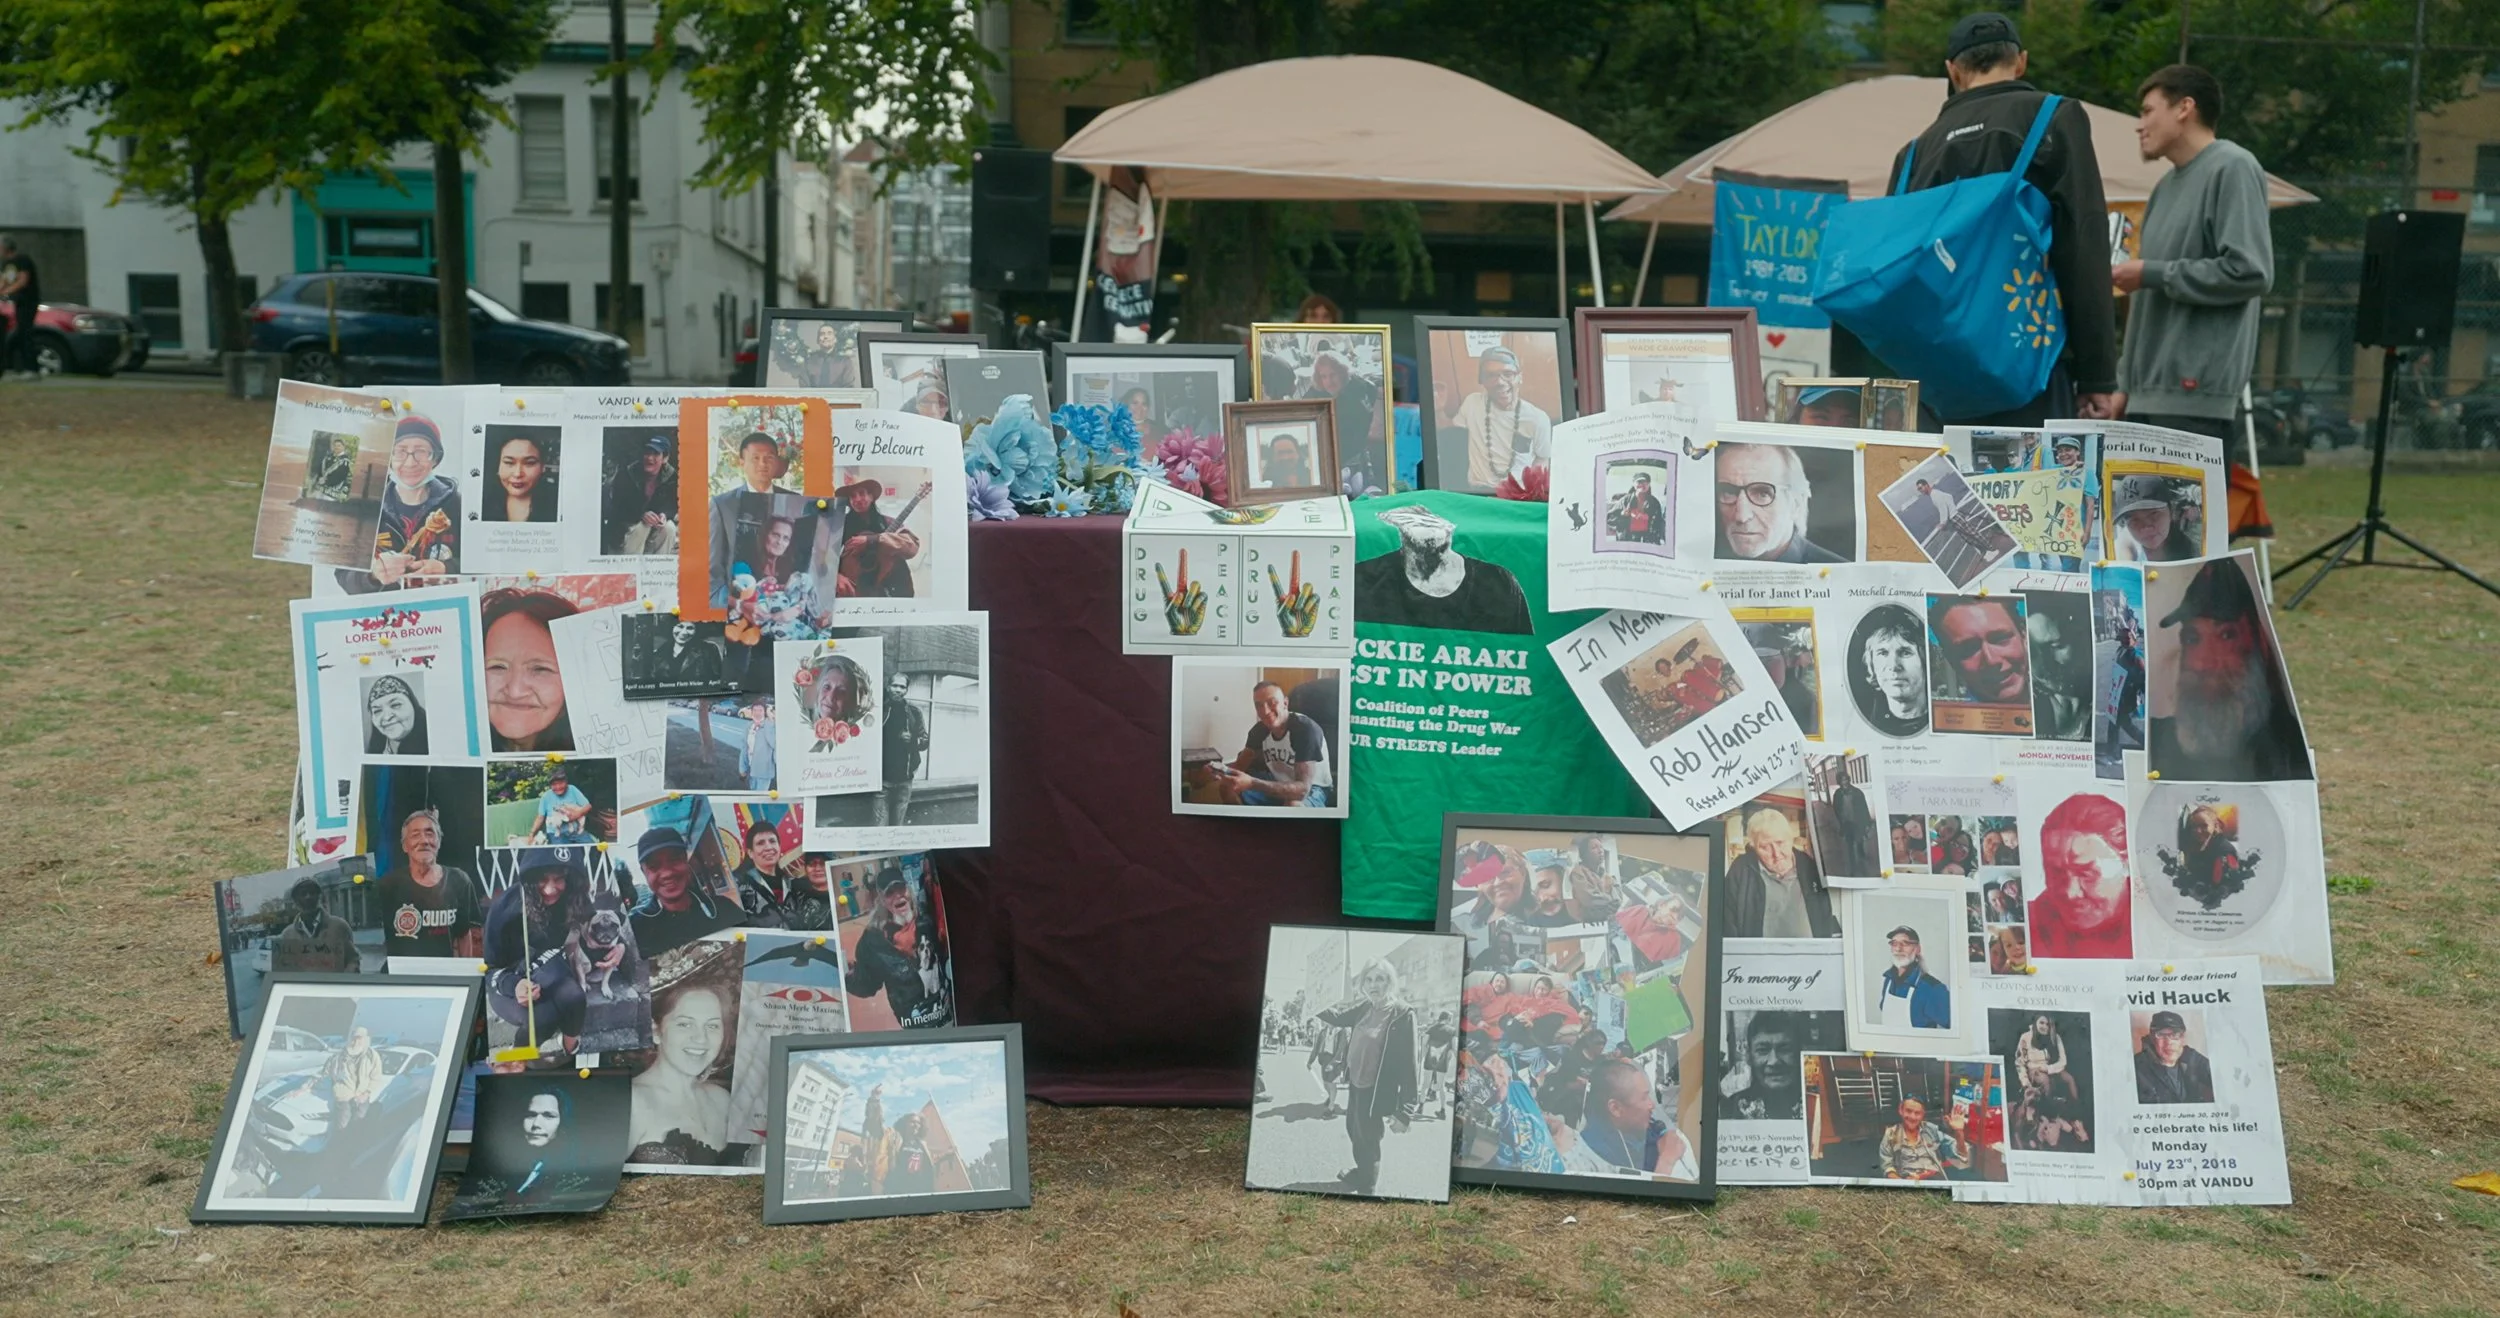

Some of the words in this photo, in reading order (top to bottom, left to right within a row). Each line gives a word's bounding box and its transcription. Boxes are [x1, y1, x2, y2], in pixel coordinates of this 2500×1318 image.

[1736, 213, 1820, 260] TAYLOR
[305, 400, 313, 409] In
[315, 401, 341, 413] Loving
[344, 405, 377, 418] Memory
[598, 396, 640, 407] VANDU
[573, 413, 608, 421] Memorial
[611, 412, 621, 421] for
[631, 412, 657, 421] beloved
[855, 419, 868, 431] Rest
[871, 420, 878, 429] In
[882, 420, 900, 430] Peace
[832, 436, 865, 461] Perry
[871, 436, 925, 457] Belcourt
[2103, 442, 2135, 453] orial
[2140, 443, 2157, 454] for
[2160, 446, 2191, 460] Janet
[2196, 452, 2222, 465] Paul
[295, 528, 315, 537] Henry
[1133, 547, 1148, 622] DRUG
[1215, 543, 1228, 639] PEACE
[1246, 549, 1260, 625] DRUG
[1328, 545, 1341, 640] PEACE
[1749, 588, 1766, 599] for
[1770, 587, 1800, 599] Janet
[1805, 588, 1831, 599] Paul
[1848, 586, 1887, 597] Mitchell
[345, 631, 398, 644] LORETTA
[401, 625, 442, 639] BROWN
[1567, 636, 1607, 673] In
[1609, 612, 1673, 646] Memo
[402, 646, 431, 654] SEPTEMBER
[1431, 645, 1529, 670] ARAKI
[1397, 668, 1428, 689] IN
[1434, 671, 1533, 696] POWER
[1355, 697, 1425, 715] Coalition
[1428, 704, 1445, 716] of
[1448, 704, 1490, 719] Peers
[1418, 718, 1443, 732] the
[1446, 719, 1487, 737] Drug
[1490, 722, 1522, 736] War
[1376, 737, 1447, 753] STREETS
[1451, 741, 1503, 756] Leader
[1650, 747, 1701, 787] Rob
[1697, 700, 1783, 762] Hansen
[2019, 752, 2055, 761] MONDAY,
[1686, 786, 1729, 812] Passed
[1728, 779, 1744, 795] on
[1742, 766, 1772, 788] July
[1921, 797, 1947, 806] TARA
[1950, 797, 1982, 807] MILLER
[422, 908, 458, 927] DUDES
[1721, 966, 1744, 984] In
[1747, 975, 1802, 991] memory
[1804, 969, 1822, 989] of
[2147, 974, 2159, 982] for
[2207, 971, 2237, 980] friend
[1981, 982, 1992, 990] IN
[1995, 982, 2032, 992] LOVING
[2035, 983, 2078, 993] MEMORY
[2081, 985, 2095, 993] OF
[1728, 995, 1764, 1005] Cookie
[1767, 996, 1803, 1005] Menow
[2017, 996, 2059, 1006] CRYSTAL
[2127, 991, 2155, 1005] vid
[2162, 988, 2231, 1005] Hauck
[763, 1003, 787, 1011] Shaun
[789, 1004, 810, 1012] Merle
[900, 1016, 912, 1027] In
[2144, 1124, 2205, 1133] celebrate
[2209, 1123, 2229, 1133] his
[2233, 1122, 2258, 1132] life!
[2152, 1140, 2208, 1153] Monday
[2201, 1158, 2237, 1169] 2018
[2138, 1177, 2178, 1190] 30pm
[2183, 1178, 2196, 1188] at
[2201, 1176, 2254, 1188] VANDU
